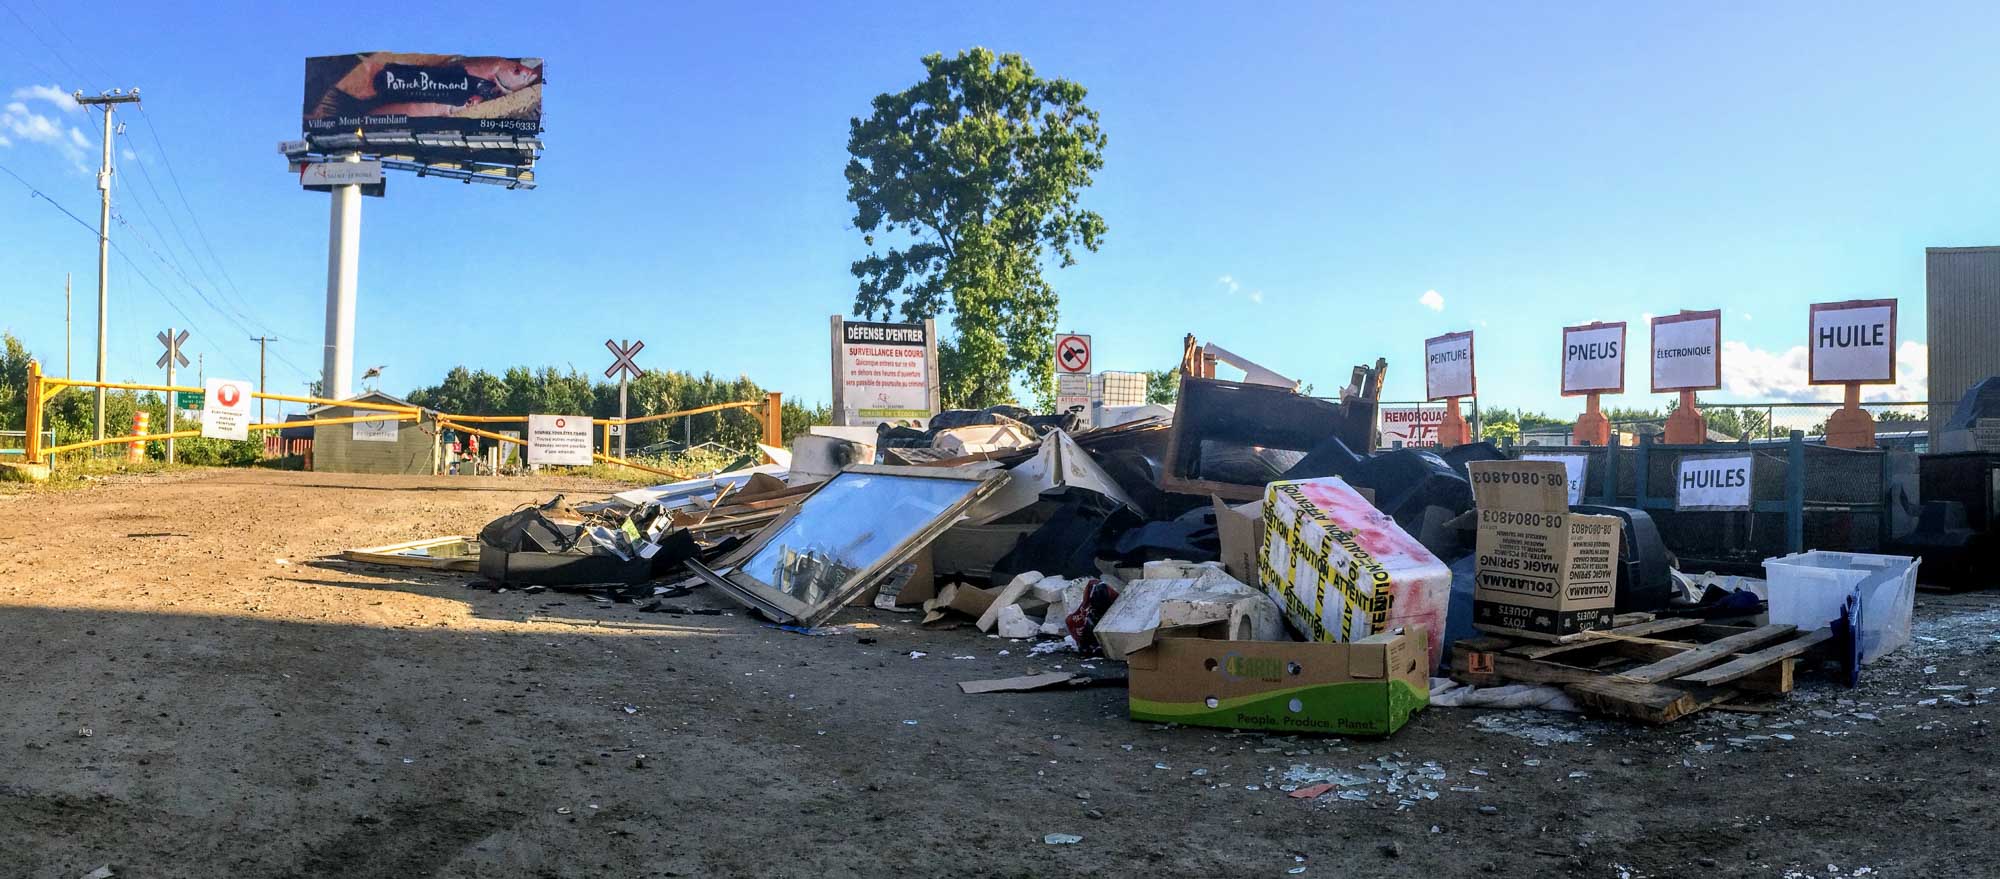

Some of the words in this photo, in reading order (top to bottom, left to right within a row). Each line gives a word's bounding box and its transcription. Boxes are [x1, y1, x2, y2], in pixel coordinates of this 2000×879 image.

[386, 71, 420, 90] Patrick
[420, 71, 468, 91] Bermand
[308, 118, 335, 129] Village
[338, 114, 407, 126] Mont-Tremblant
[848, 325, 884, 340] DÉFENSE
[885, 328, 924, 342] D'ENTRER
[1819, 324, 1884, 348] HUILE
[849, 347, 893, 357] SURVEILLANCE
[894, 349, 903, 357] EN
[904, 349, 924, 358] COURS
[1430, 349, 1467, 365] PEINTURE
[1568, 341, 1617, 361] PNEUS
[1656, 345, 1711, 359] ÉLECTRONIQUE
[1473, 471, 1563, 487] 08-0804803
[1683, 468, 1745, 489] HUILES
[1483, 509, 1562, 528] 08-0804803
[1480, 555, 1520, 570] SPRING
[1523, 559, 1559, 574] MAGIC
[1569, 569, 1591, 580] SPRING
[1592, 569, 1612, 579] MAGIC
[1483, 574, 1553, 593] DOLLARAMA
[1569, 585, 1608, 595] DOLLARAMA
[1498, 605, 1534, 617] JOUETS
[1577, 611, 1599, 620] JOUETS
[1503, 617, 1526, 628] TOYS
[1579, 622, 1594, 630] TOYS
[1238, 713, 1279, 726] People.
[1284, 716, 1333, 728] Produce.
[1338, 718, 1377, 730] Planet.
